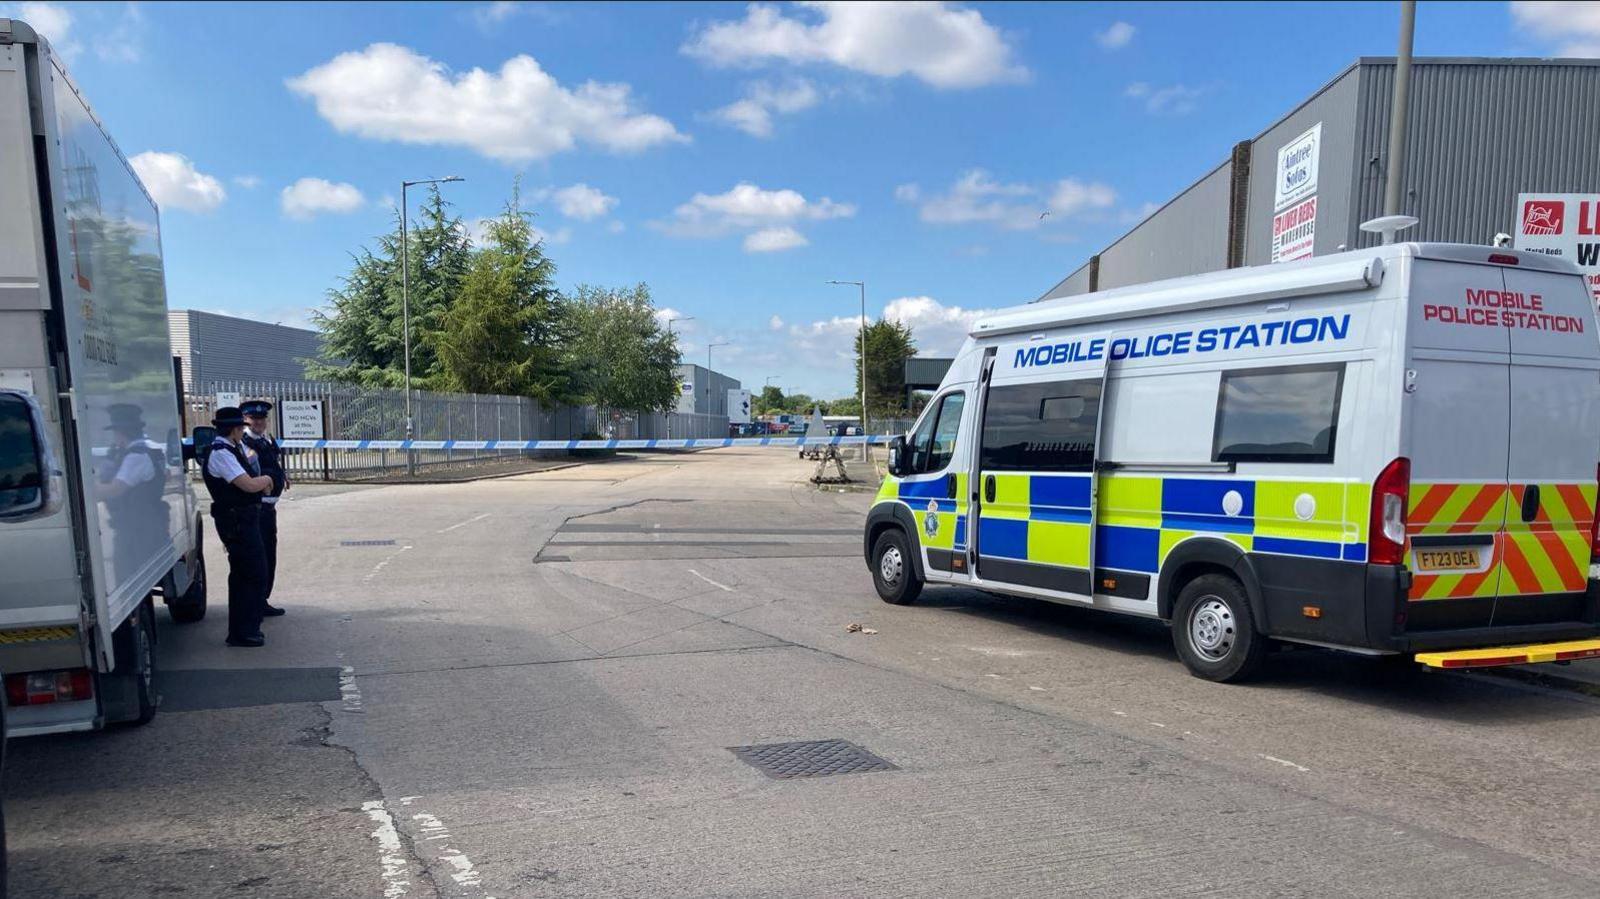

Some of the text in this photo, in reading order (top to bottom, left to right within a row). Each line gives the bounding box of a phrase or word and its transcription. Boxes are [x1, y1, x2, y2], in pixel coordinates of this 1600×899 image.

[1286, 167, 1306, 189] Sofas
[1281, 199, 1315, 231] LIVER BEDS
[1281, 220, 1314, 246] WAREHOUSE
[1466, 288, 1543, 311] MOBILE
[1423, 304, 1584, 334] POLICE STATION
[1013, 314, 1351, 369] MOBILE OLICE STATION
[1421, 551, 1476, 567] FT23 OEA
